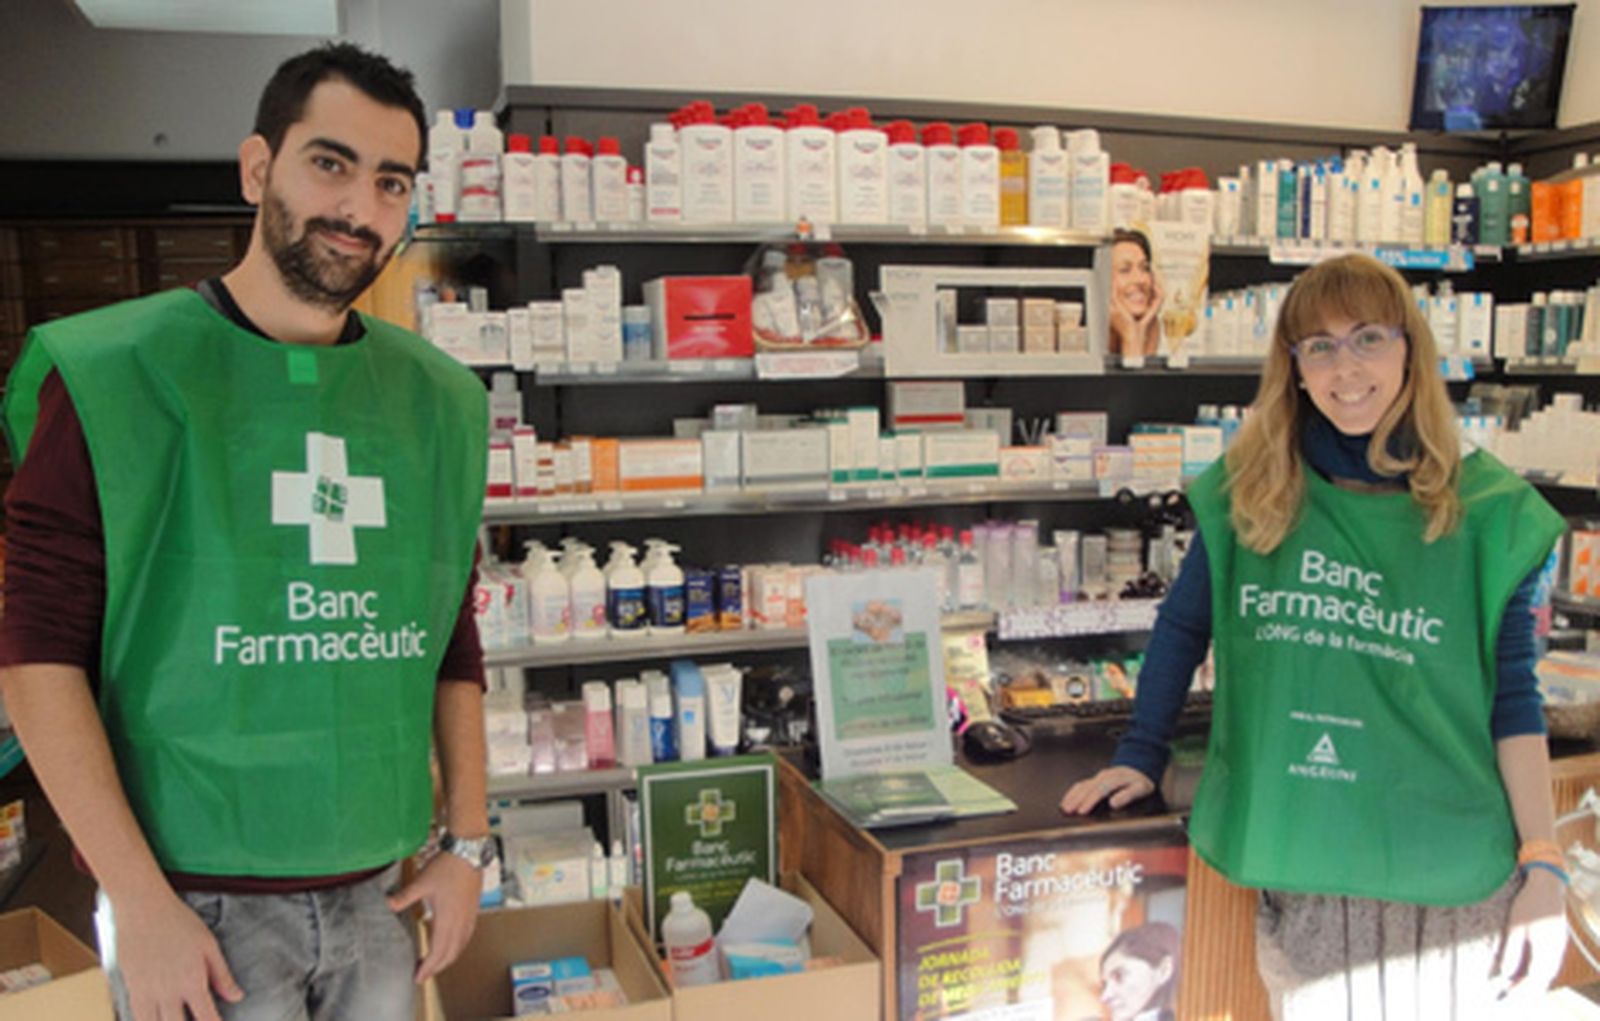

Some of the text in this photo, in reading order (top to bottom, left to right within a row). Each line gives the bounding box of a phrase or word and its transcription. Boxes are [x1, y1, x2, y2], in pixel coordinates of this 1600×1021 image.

[1300, 549, 1383, 597] Banc
[287, 580, 378, 621] Banc
[1238, 583, 1444, 644] Farmacèutic
[214, 620, 427, 666] Farmacèutic
[1304, 628, 1326, 646] de
[1328, 631, 1344, 649] la
[996, 852, 1057, 879] Banc
